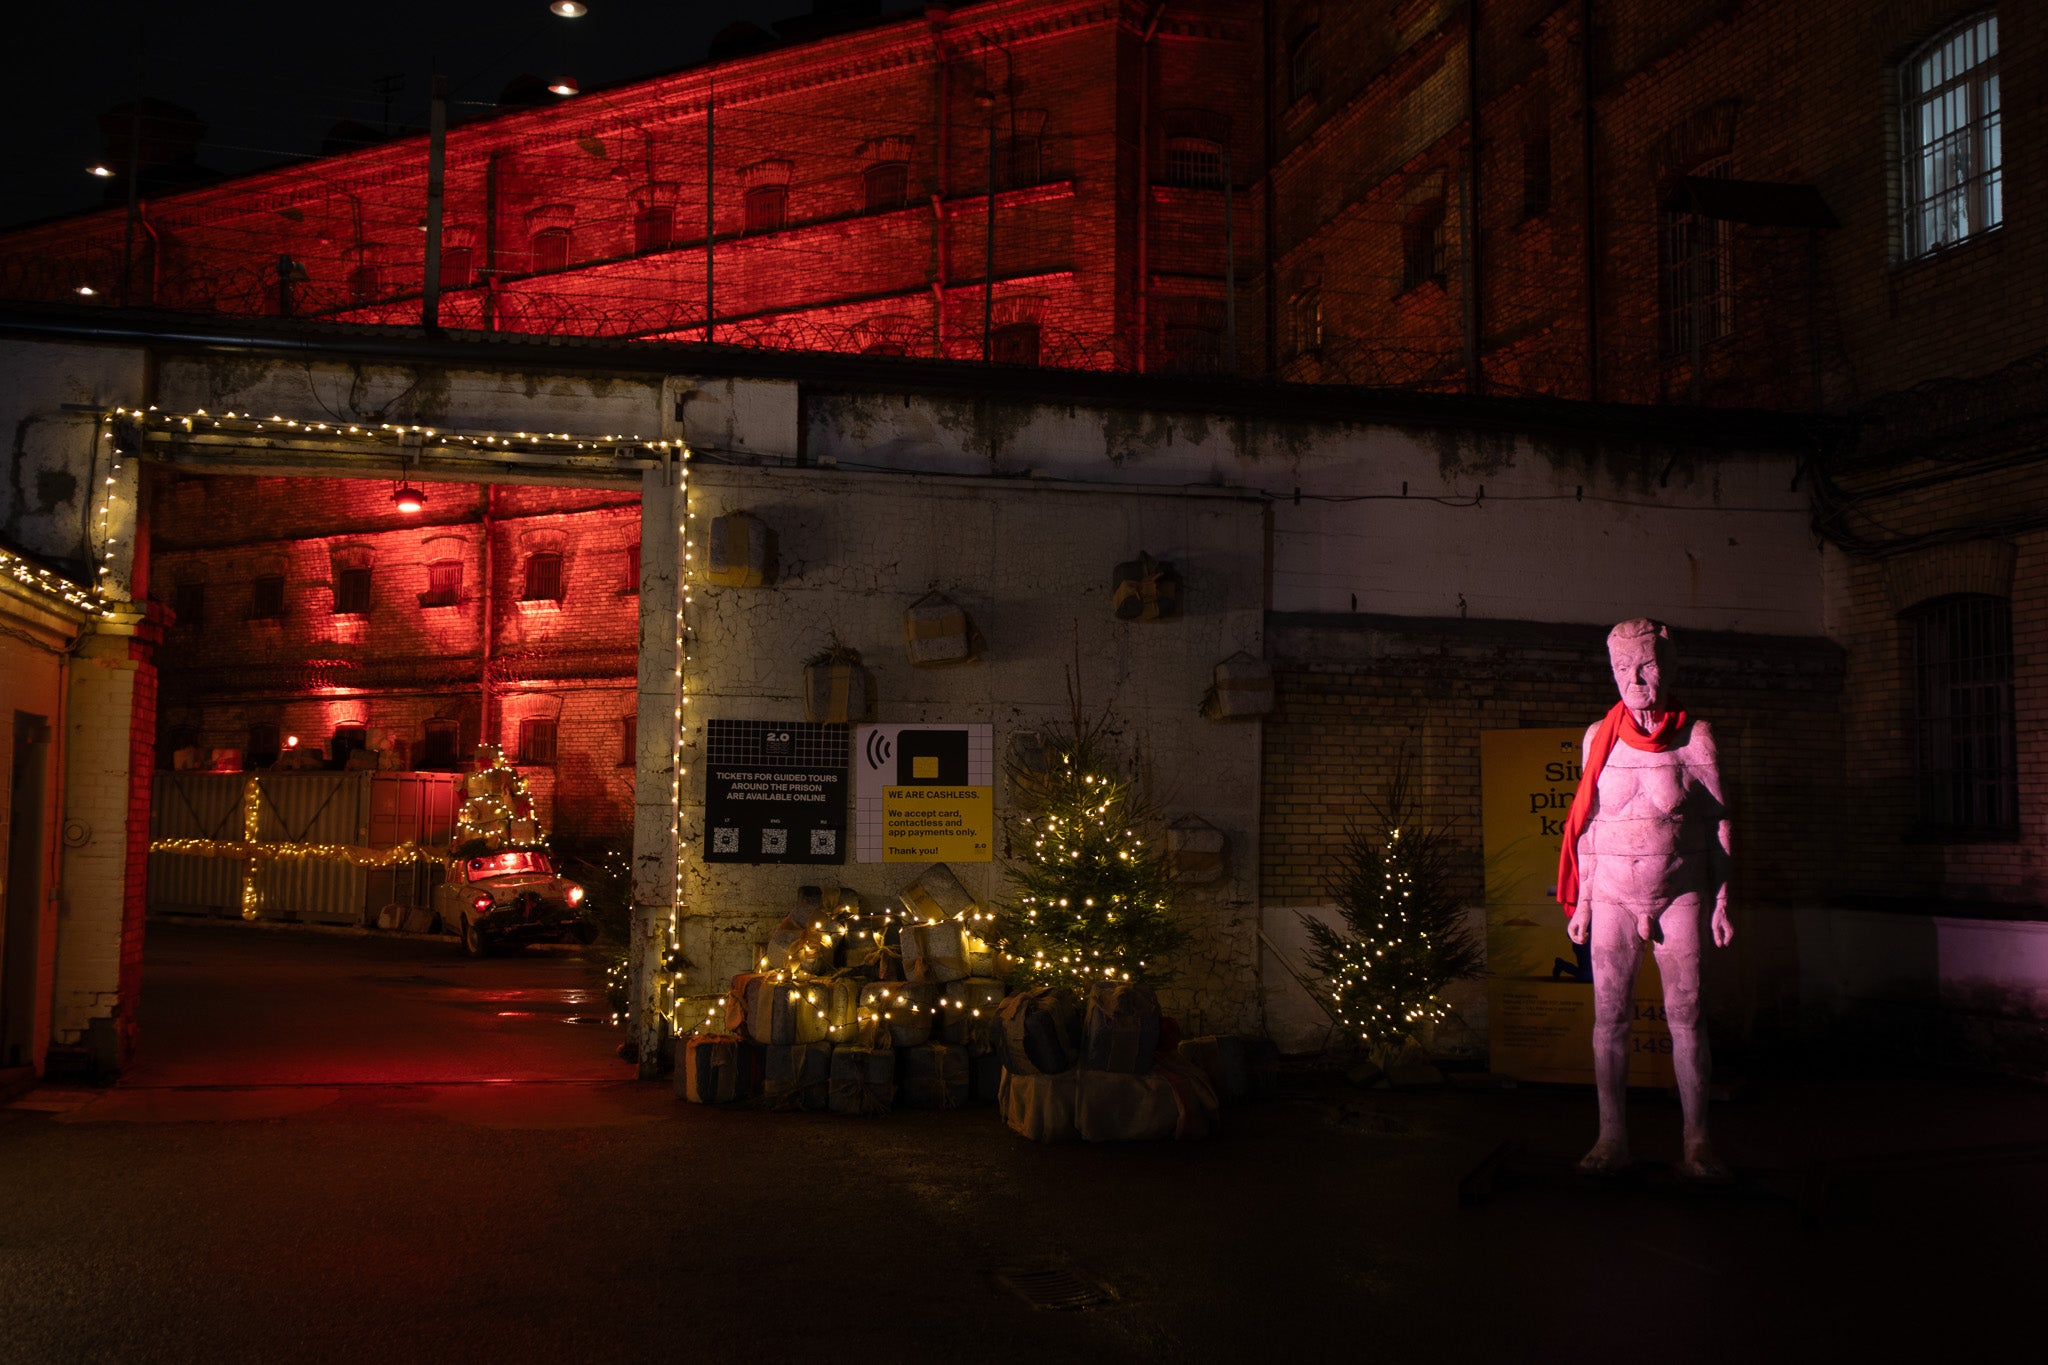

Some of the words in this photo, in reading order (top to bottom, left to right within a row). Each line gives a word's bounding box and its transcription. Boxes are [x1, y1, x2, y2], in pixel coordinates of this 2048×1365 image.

[766, 732, 790, 742] 2.0
[716, 772, 753, 781] TICKETS
[754, 773, 772, 781] FOR
[773, 773, 807, 782] GUIDED
[808, 774, 838, 783] TOURS
[731, 782, 769, 791] AROUND
[770, 783, 788, 791] THE
[789, 783, 822, 792] PRISON
[726, 792, 745, 800] ARE
[745, 792, 792, 801] AVAILABLE
[793, 793, 826, 802] ONLINE
[888, 791, 903, 799] WE
[904, 791, 925, 799] ARE
[926, 791, 980, 799] CASHLESS.
[888, 810, 902, 818] We
[904, 810, 937, 820] accept
[938, 810, 962, 819] card,
[888, 819, 943, 827] contactless
[945, 819, 962, 827] and
[888, 829, 906, 838] app
[908, 828, 954, 838] payments
[955, 828, 977, 838] only.
[888, 847, 917, 855] Thank
[919, 847, 939, 857] you!
